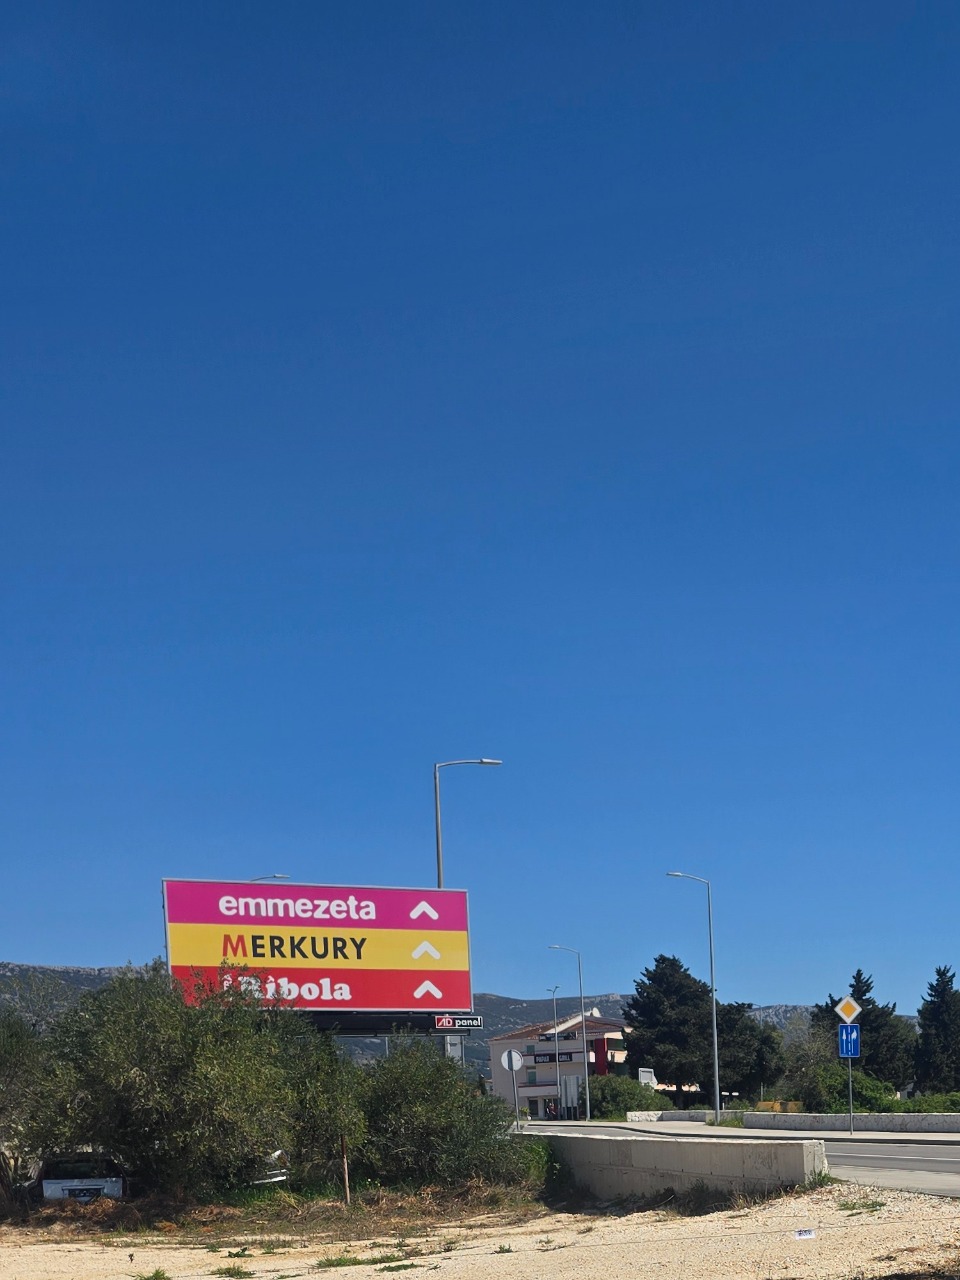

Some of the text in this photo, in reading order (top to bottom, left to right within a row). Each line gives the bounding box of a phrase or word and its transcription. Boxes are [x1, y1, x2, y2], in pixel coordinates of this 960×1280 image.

[218, 895, 377, 921] emmezeta
[221, 933, 368, 960] MERKURY
[455, 1016, 481, 1028] panel
